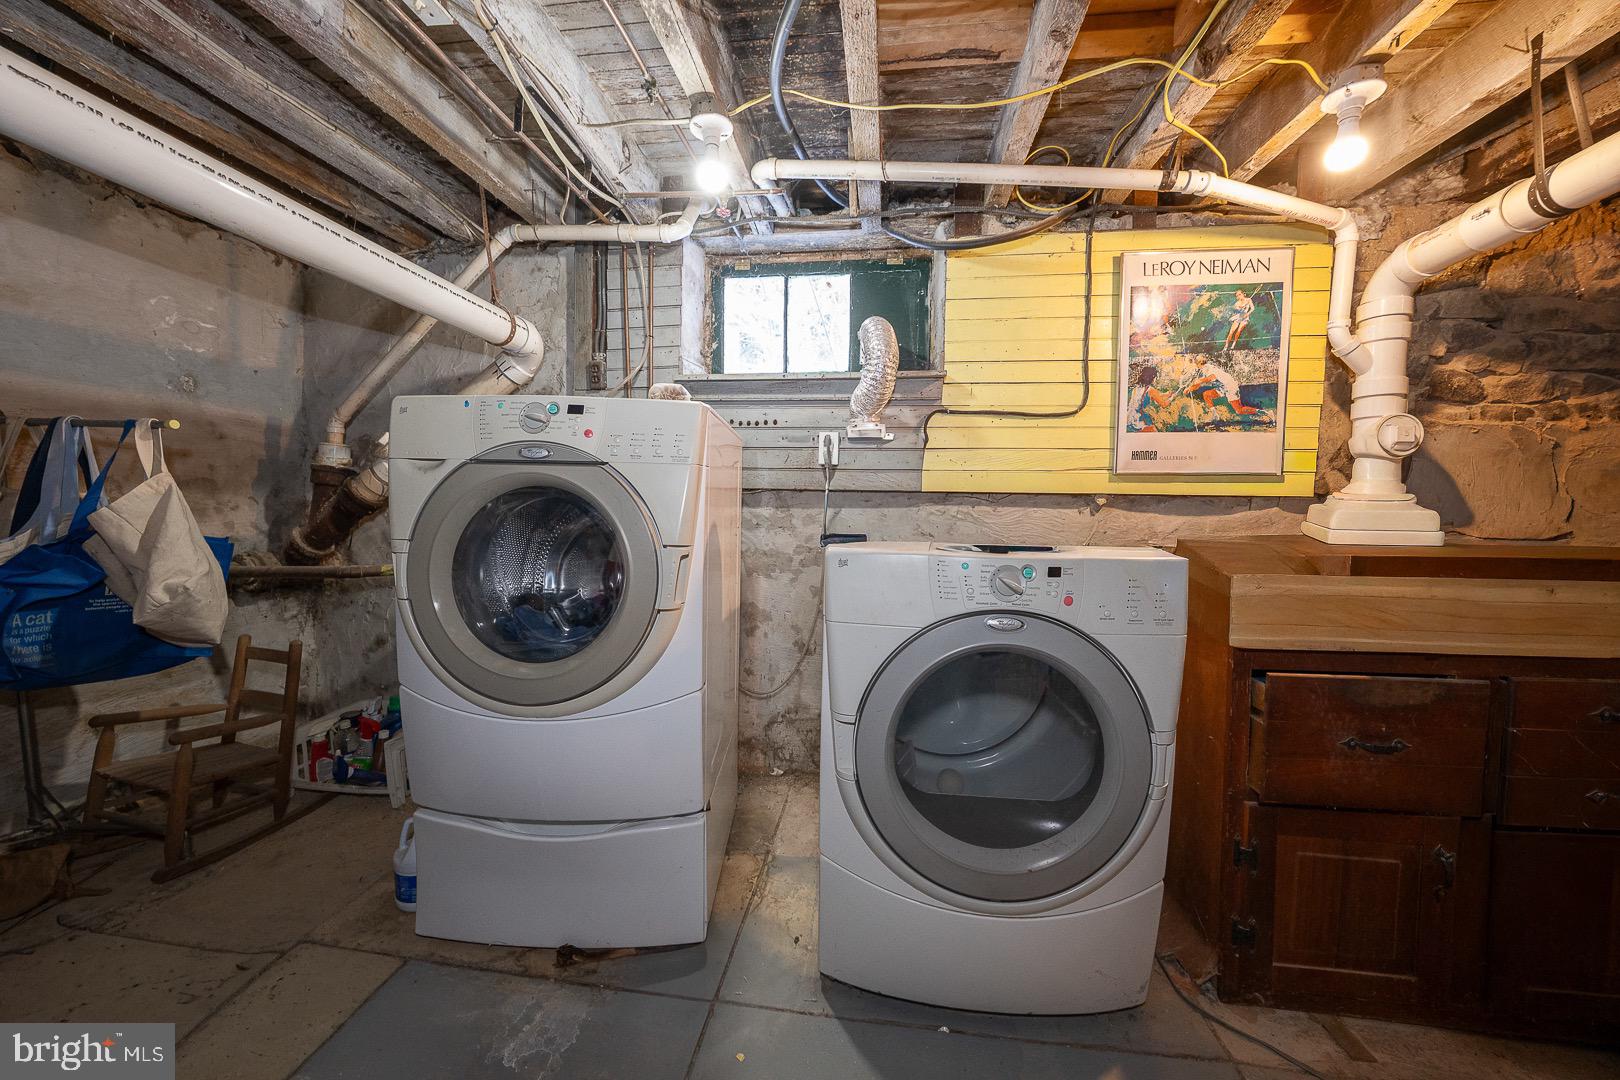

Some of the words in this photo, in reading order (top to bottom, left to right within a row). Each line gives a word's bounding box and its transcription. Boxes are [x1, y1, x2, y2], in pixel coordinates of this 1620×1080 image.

[1199, 257, 1271, 275] NEIMAN
[12, 613, 22, 628] A
[25, 610, 54, 626] cat
[23, 632, 53, 643] which
